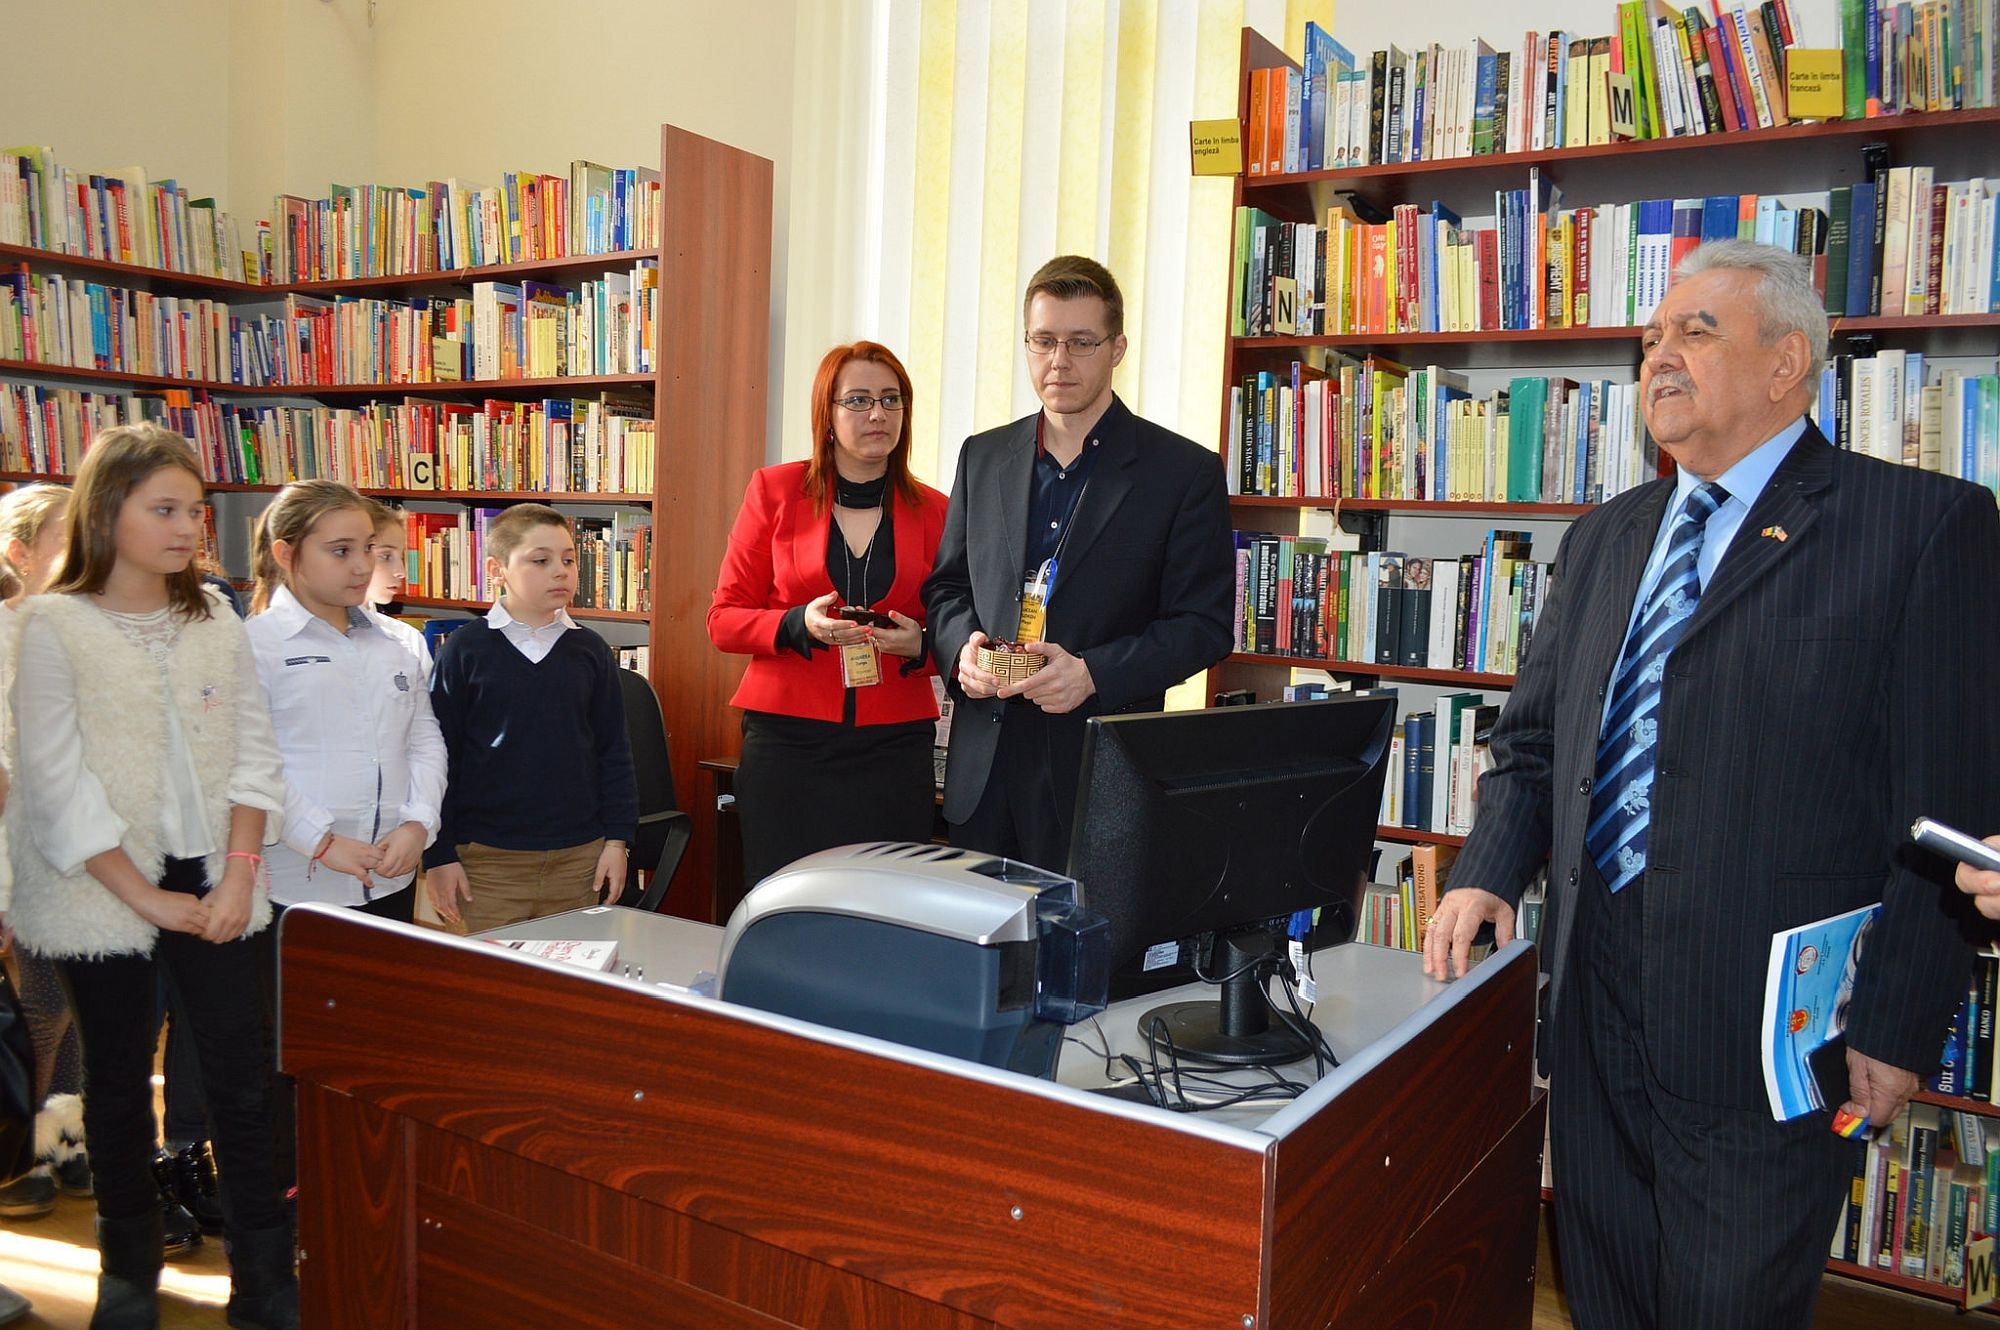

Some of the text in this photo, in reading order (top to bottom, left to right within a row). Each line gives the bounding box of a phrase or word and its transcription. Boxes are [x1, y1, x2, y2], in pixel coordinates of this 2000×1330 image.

[1733, 8, 1752, 54] twelve
[1303, 53, 1312, 80] Human
[1549, 37, 1558, 74] OUTCAST
[1302, 81, 1311, 100] Body
[1789, 71, 1810, 82] Carte
[1819, 71, 1841, 82] limba
[1613, 86, 1633, 126] M
[1193, 137, 1213, 146] Carte
[1221, 135, 1240, 145] limba
[1550, 242, 1564, 291] BLASPHEMY
[1279, 289, 1292, 324] N
[1551, 386, 1560, 429] Shakespeare
[1860, 376, 1872, 455] DENCES ROYALES
[1246, 418, 1254, 447] SHARED
[1395, 412, 1403, 444] ROBINSON
[414, 461, 429, 484] C
[1258, 545, 1270, 615] american literature
[1320, 558, 1328, 568] THE
[1417, 863, 1428, 926] CIVILISATIONS
[1979, 1009, 1991, 1038] FRANCO
[1968, 1251, 1994, 1296] W
